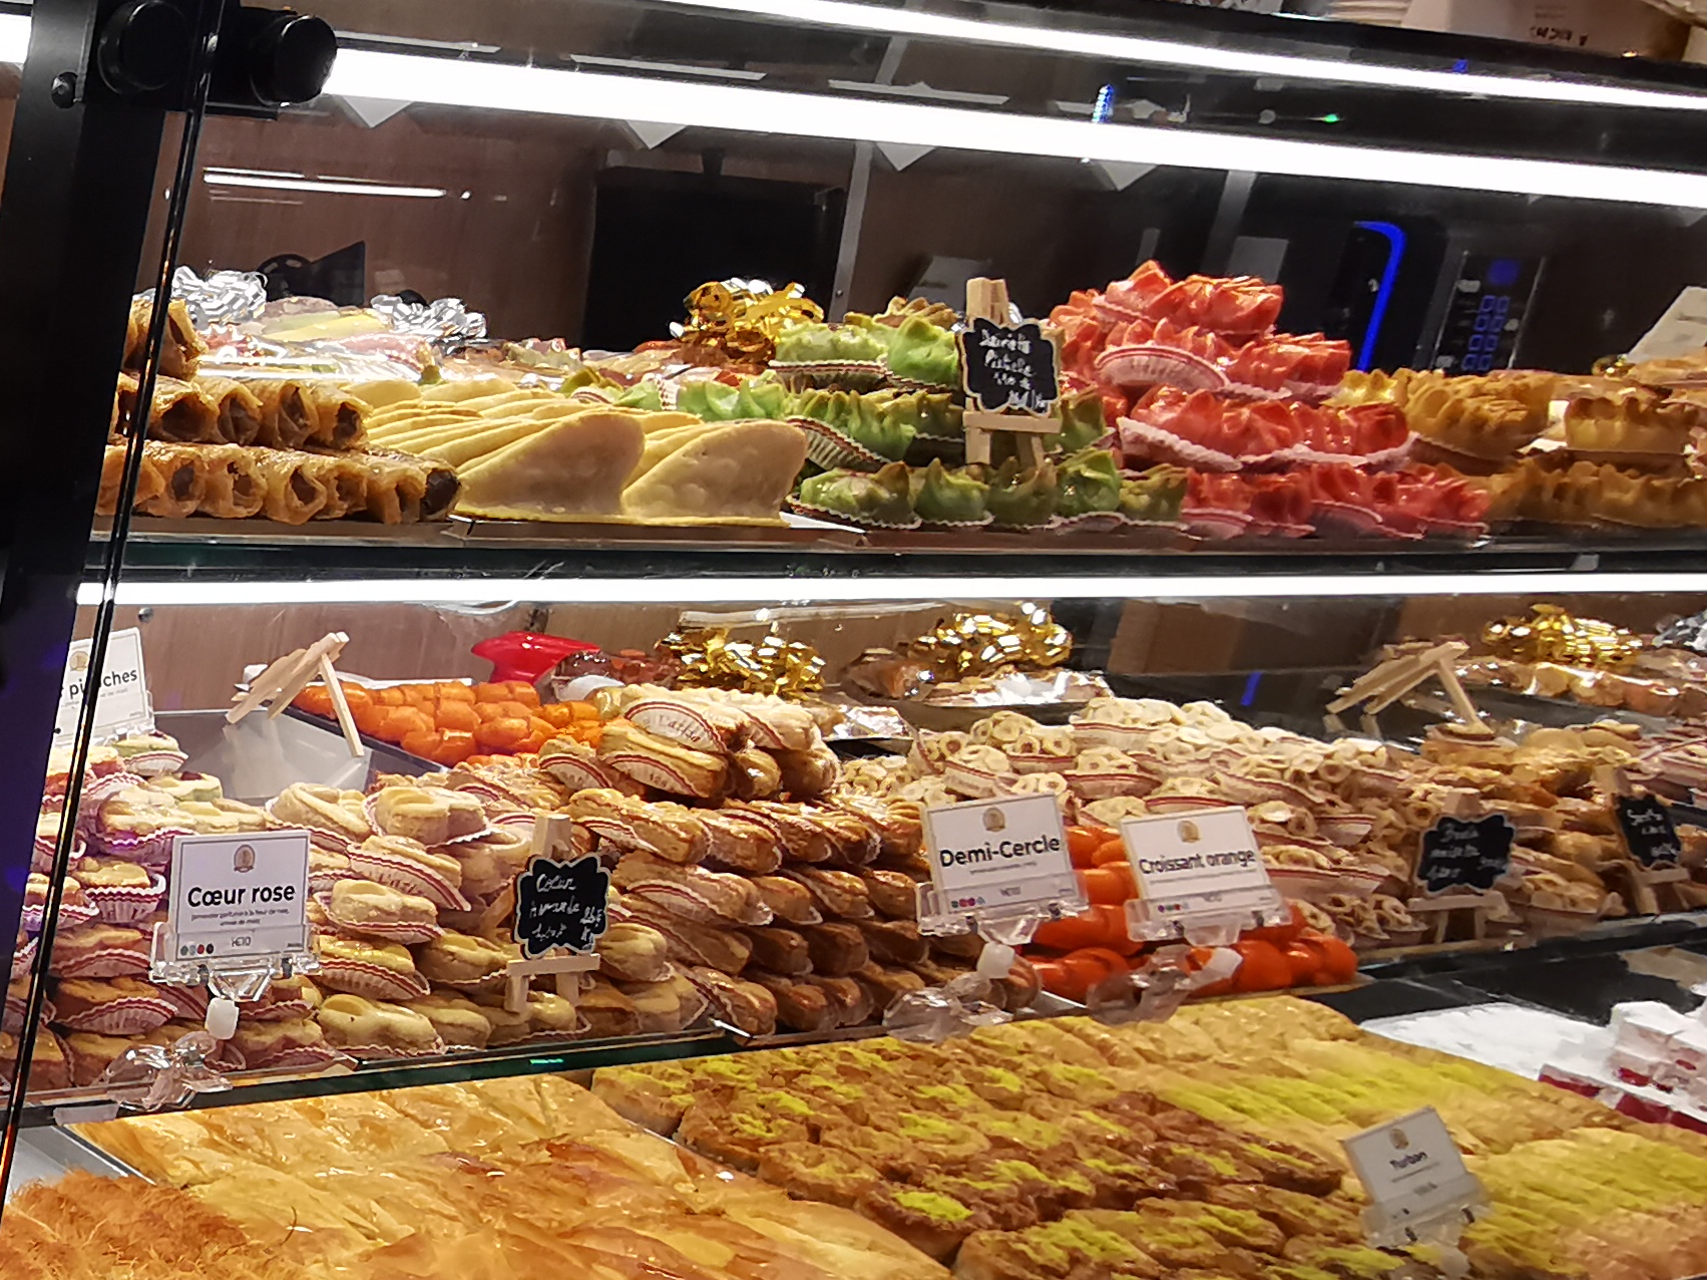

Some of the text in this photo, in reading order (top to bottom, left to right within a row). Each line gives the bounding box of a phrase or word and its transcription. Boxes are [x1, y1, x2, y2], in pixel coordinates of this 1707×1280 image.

[939, 834, 1061, 868] Demi-Cercle
[187, 884, 296, 908] Cœur rose
